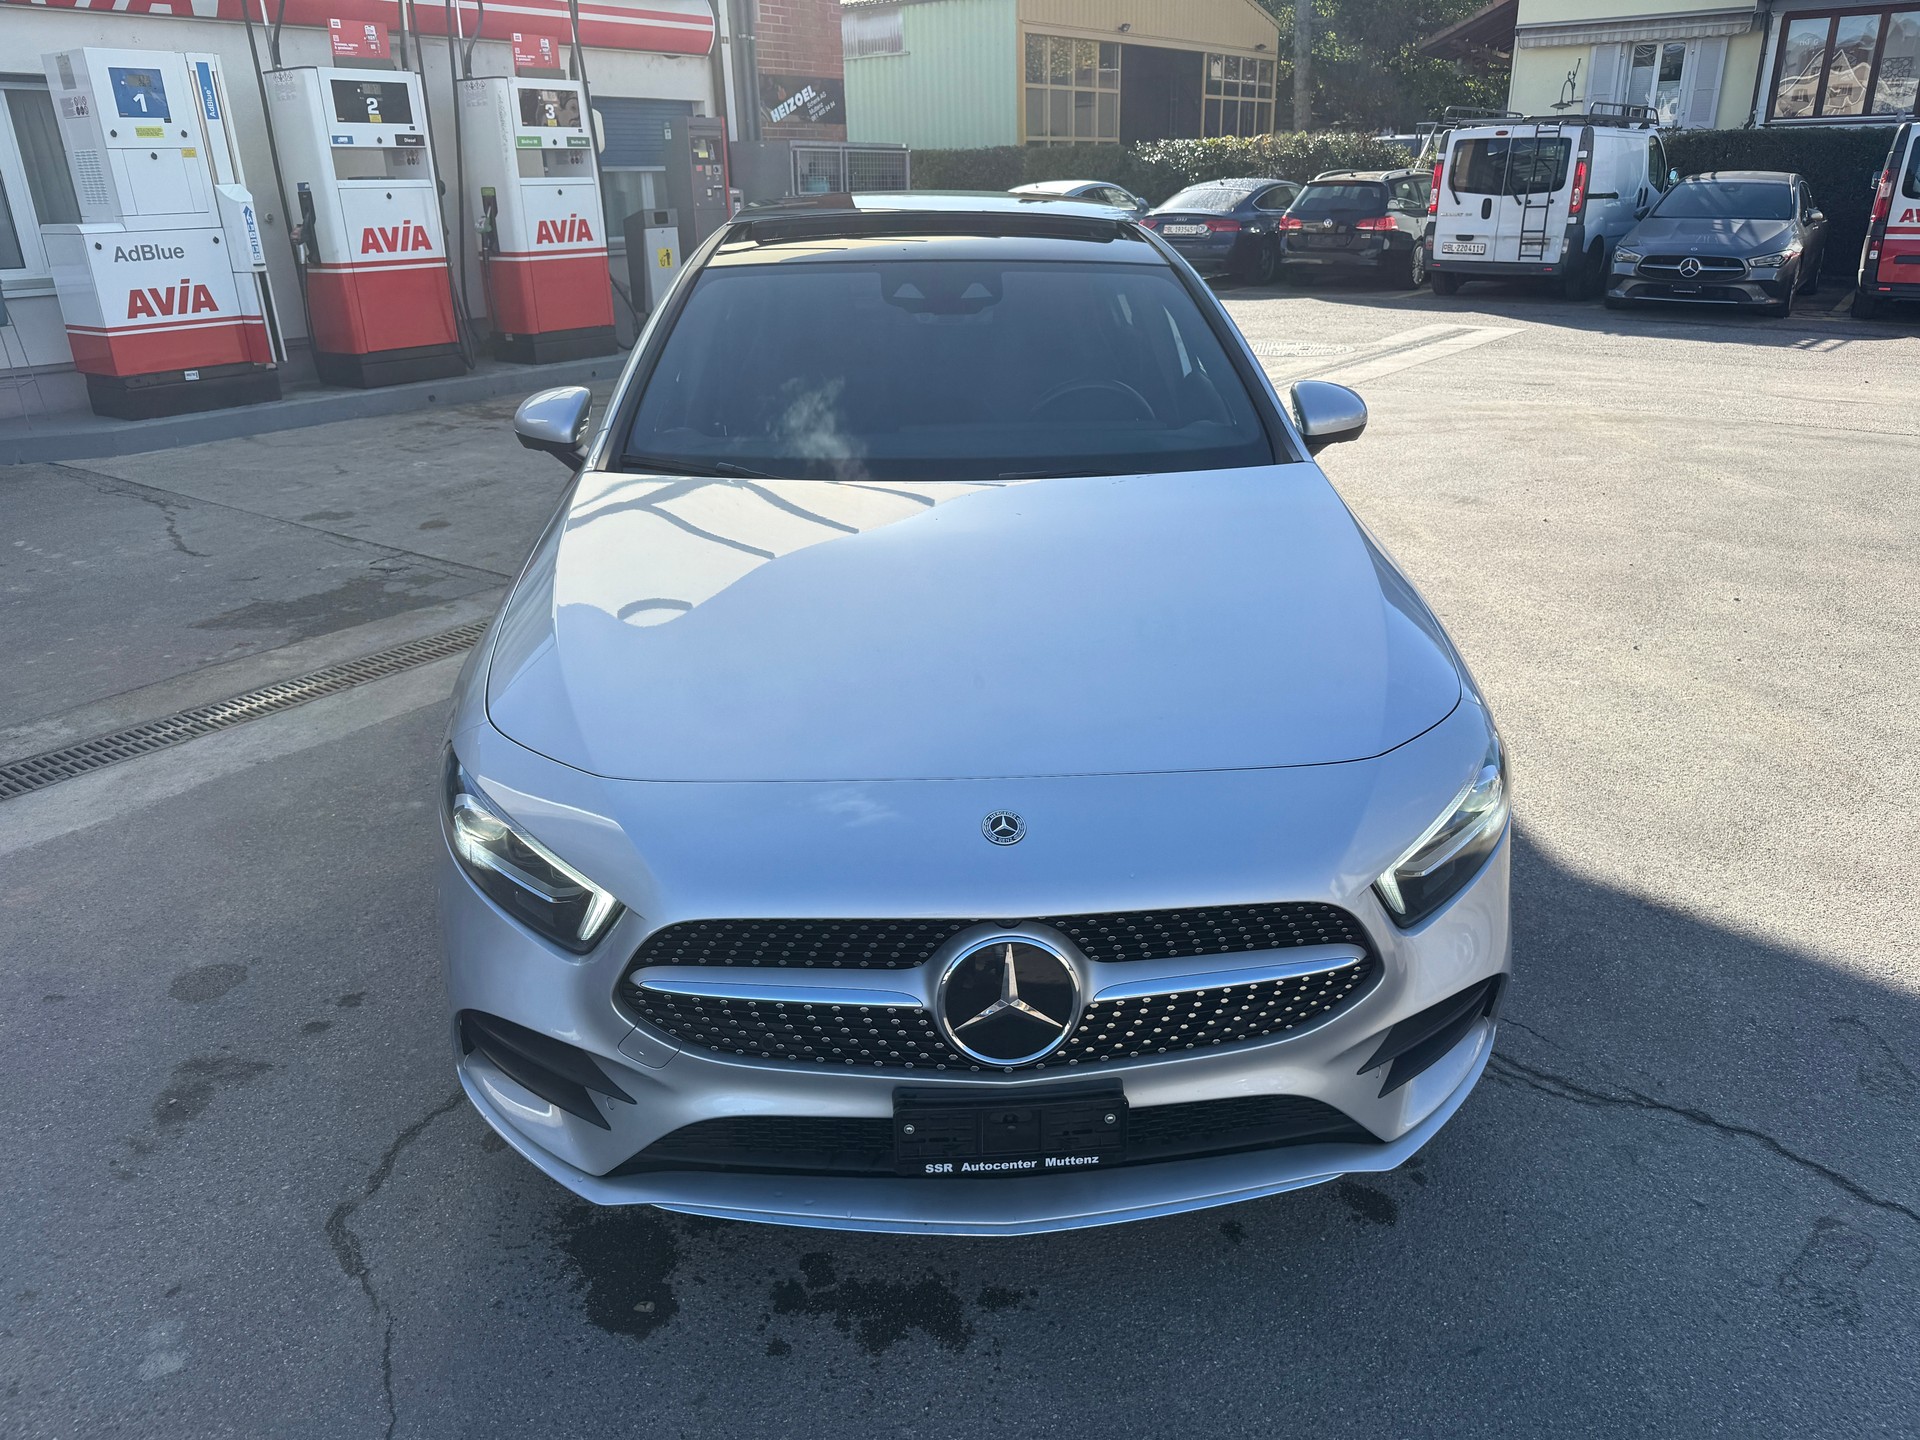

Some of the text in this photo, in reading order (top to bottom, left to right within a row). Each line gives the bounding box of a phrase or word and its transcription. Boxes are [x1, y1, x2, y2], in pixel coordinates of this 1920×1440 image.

[133, 93, 148, 113] 1
[366, 97, 380, 115] 2
[545, 104, 556, 119] 3
[770, 85, 817, 123] HEIZOEL
[1899, 208, 1920, 223] A
[360, 219, 433, 254] AVIA
[536, 213, 594, 245] AVIA
[113, 243, 185, 263] AdBlue
[127, 278, 219, 319] AVIA
[925, 1154, 1099, 1174] SSR Autocenter Muttenz
